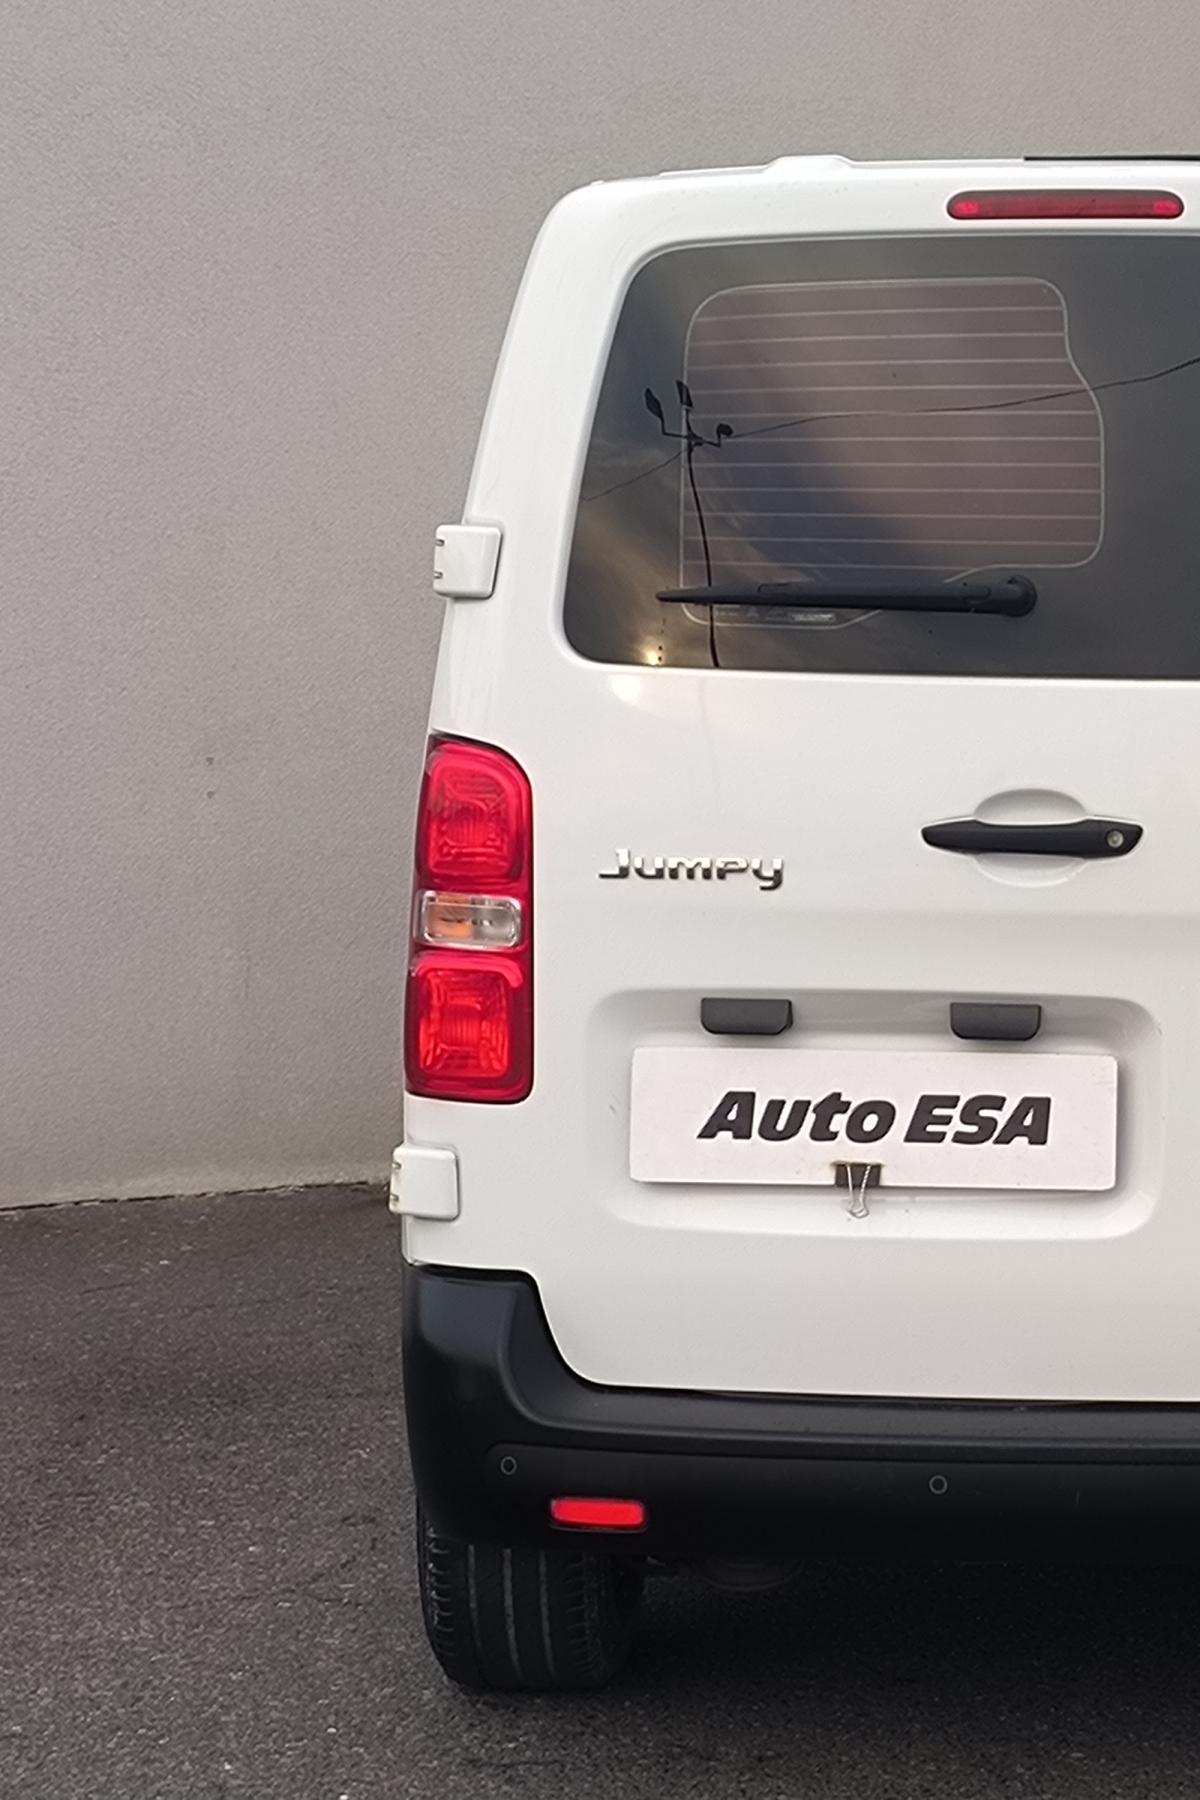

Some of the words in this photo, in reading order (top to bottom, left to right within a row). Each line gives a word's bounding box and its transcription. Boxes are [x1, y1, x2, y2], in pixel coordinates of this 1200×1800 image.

[598, 848, 784, 891] Jumpy
[697, 1090, 897, 1144] Auto
[903, 1094, 1052, 1146] ESA
